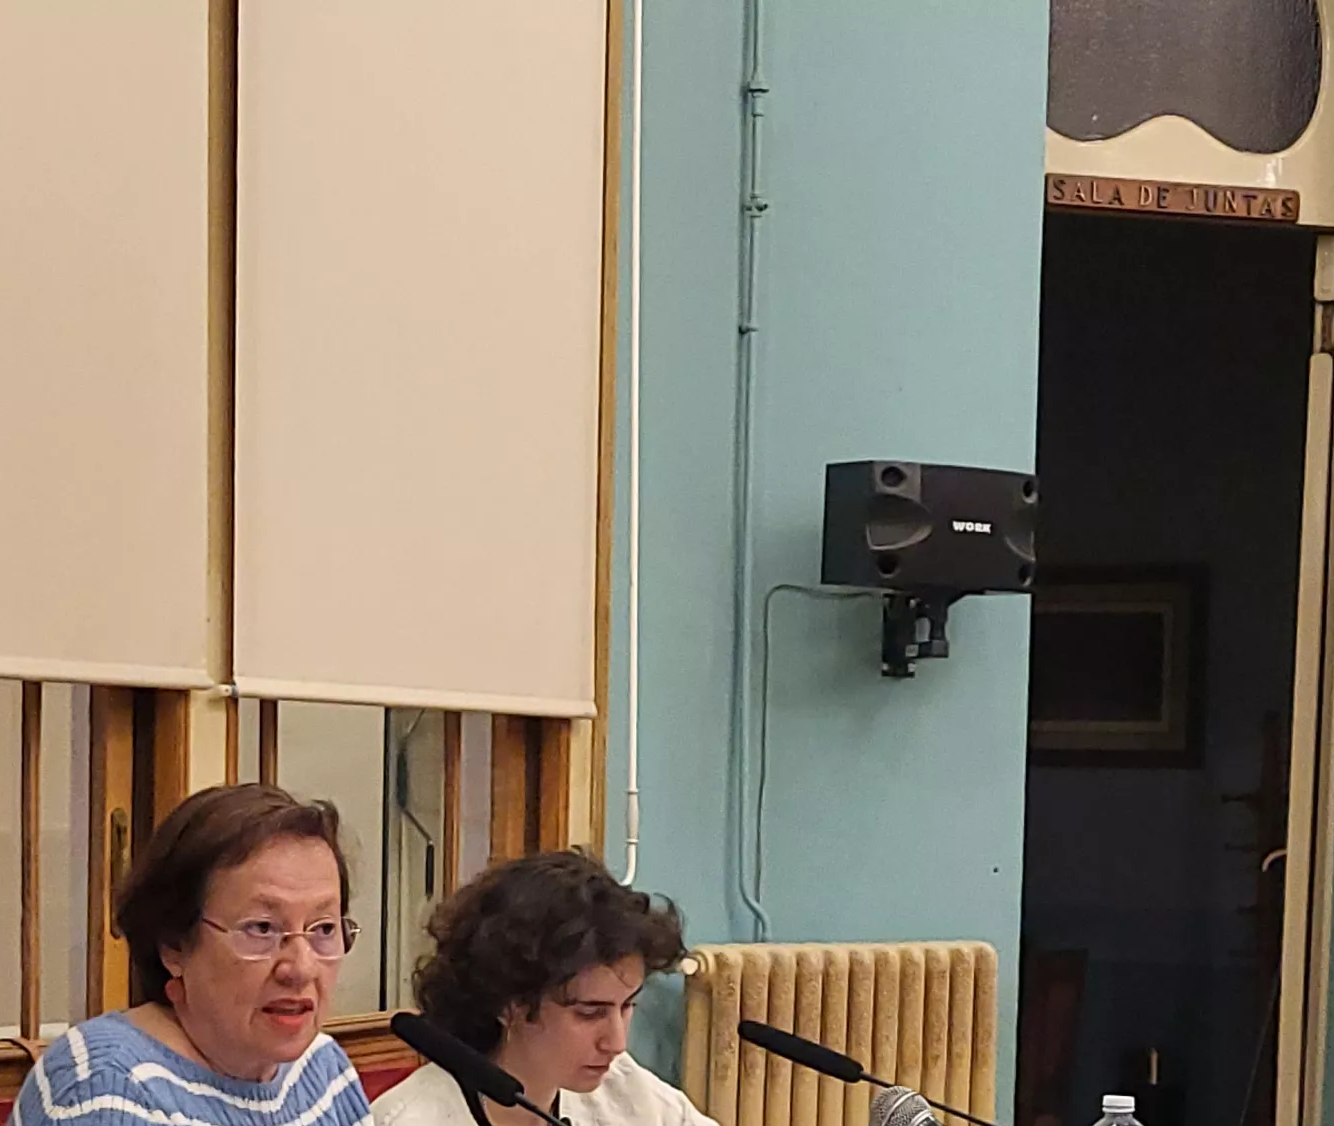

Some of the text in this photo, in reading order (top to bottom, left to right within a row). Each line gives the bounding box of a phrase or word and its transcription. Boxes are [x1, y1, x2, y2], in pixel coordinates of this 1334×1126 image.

[1052, 179, 1294, 218] SALA DE JUNTAS
[953, 520, 991, 534] WORK
